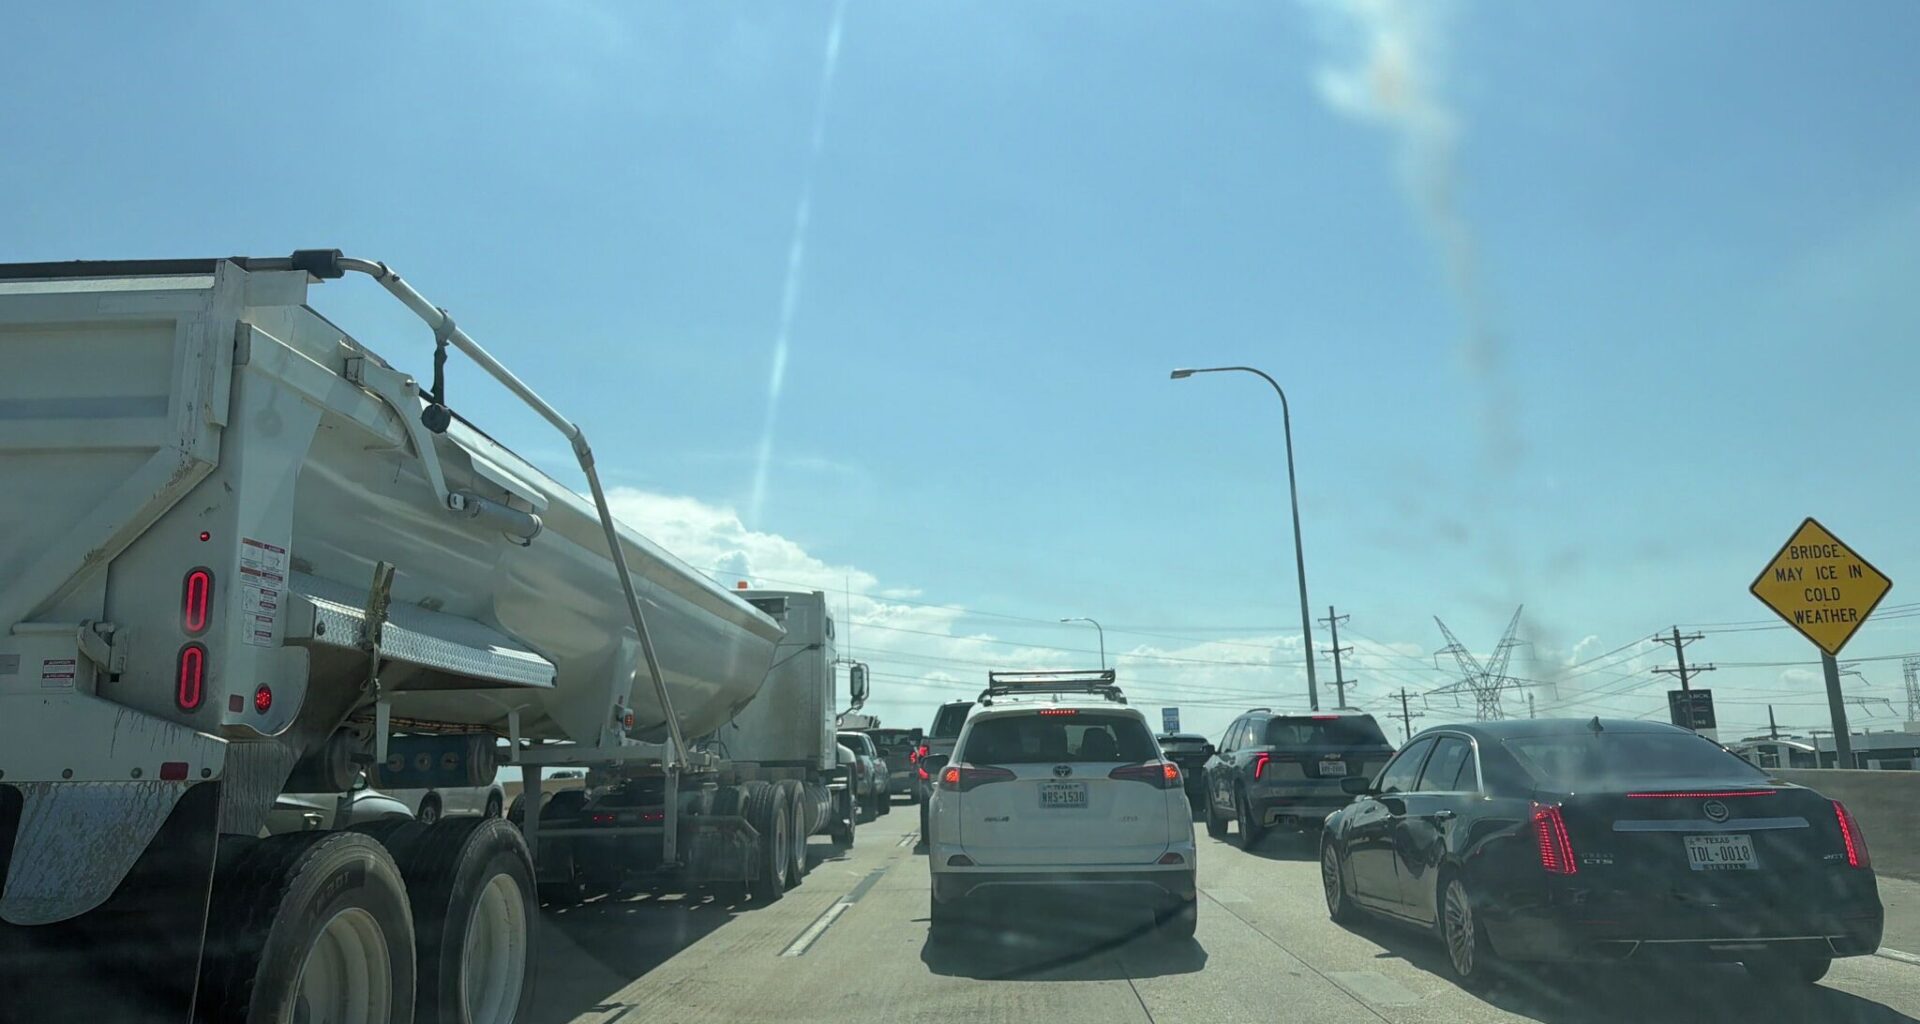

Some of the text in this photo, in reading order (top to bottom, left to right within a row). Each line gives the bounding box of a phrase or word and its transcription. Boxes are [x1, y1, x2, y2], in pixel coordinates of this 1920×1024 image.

[1790, 544, 1840, 559] BRIDGE
[1775, 564, 1863, 582] MAY ICE IN
[1804, 587, 1840, 602] COLD
[1794, 608, 1858, 624] WEATHER
[1704, 836, 1730, 844] TEXAS
